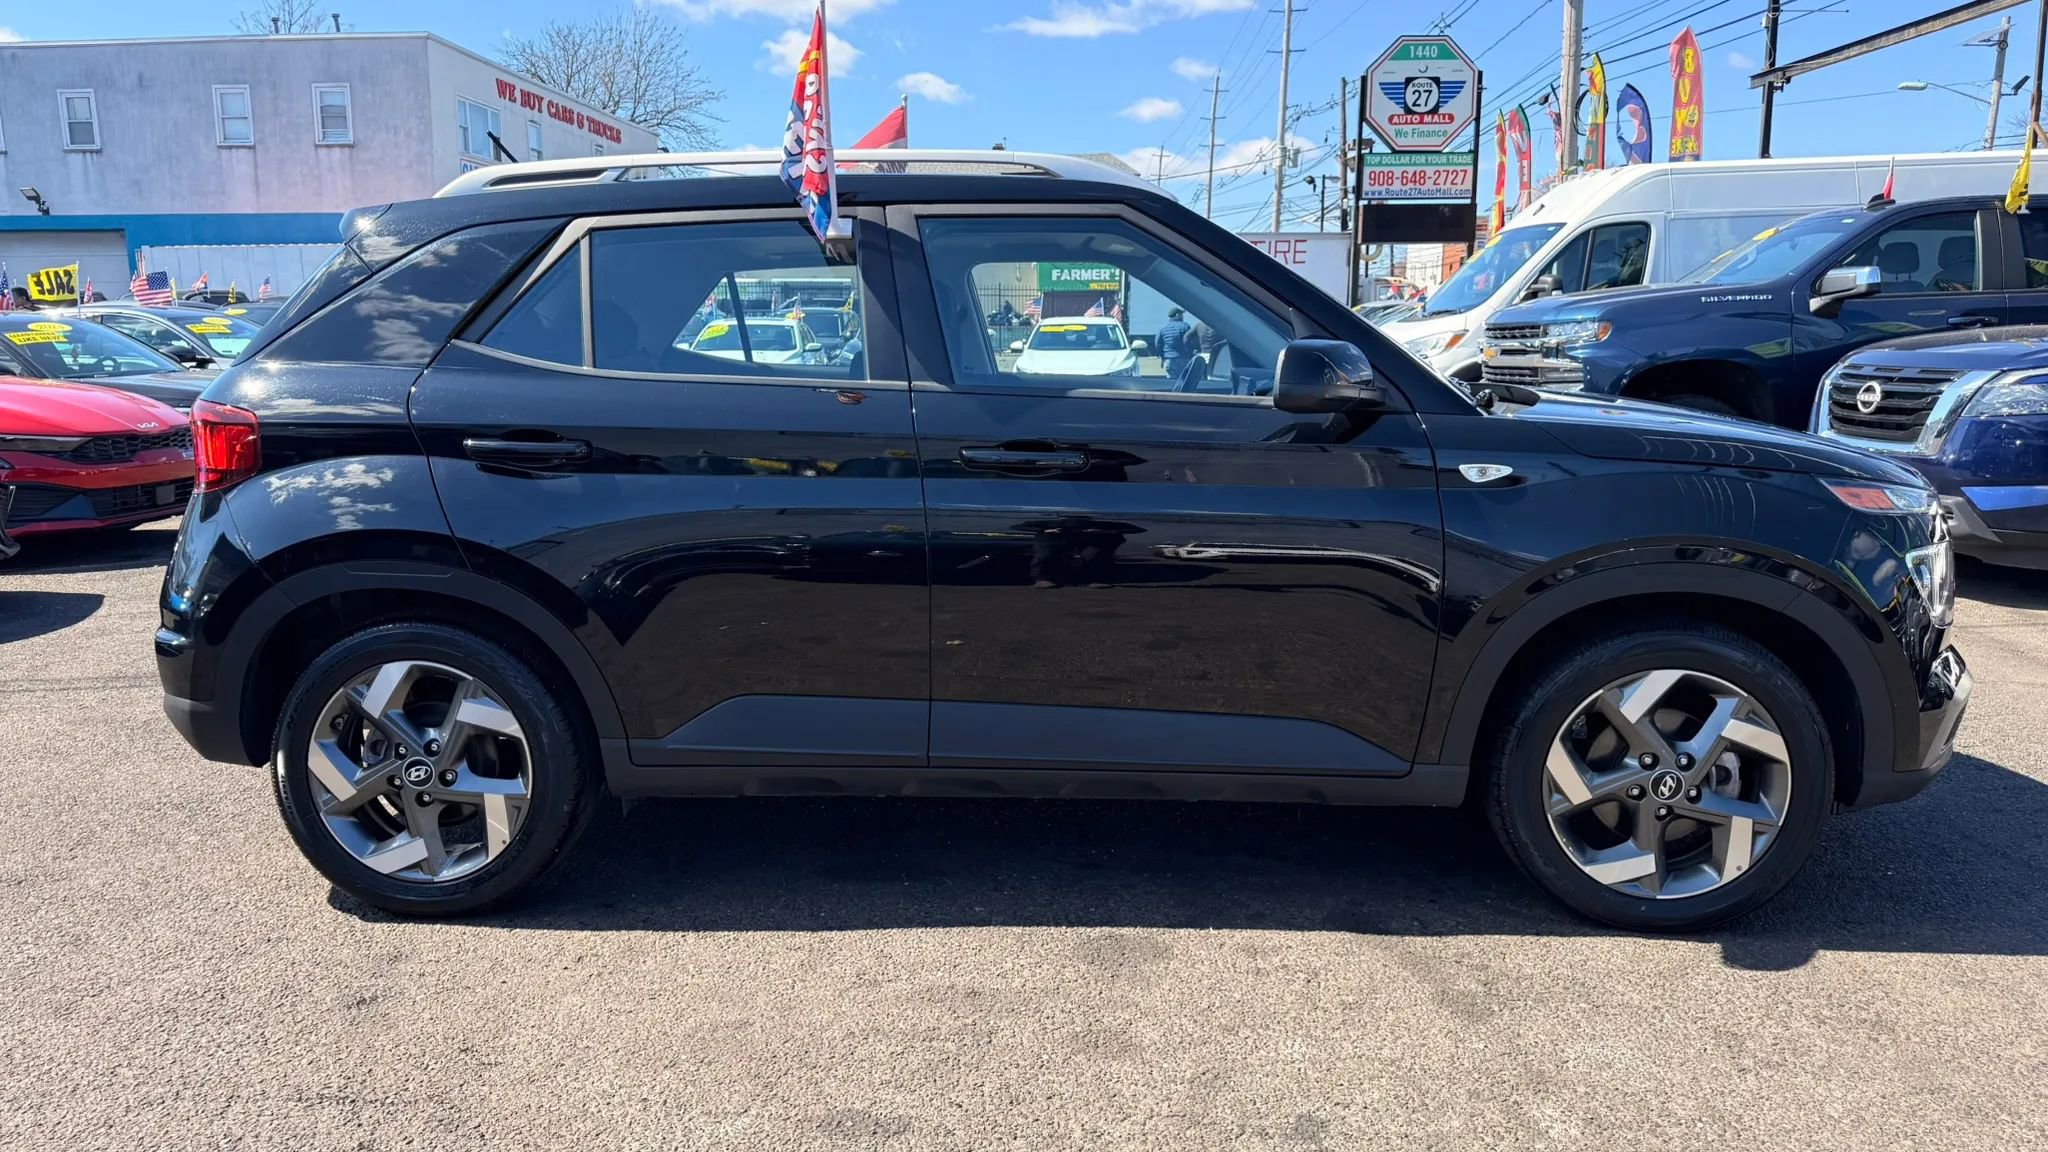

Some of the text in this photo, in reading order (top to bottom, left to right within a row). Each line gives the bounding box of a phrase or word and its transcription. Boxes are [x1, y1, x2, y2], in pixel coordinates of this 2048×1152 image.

[1409, 45, 1438, 58] 1440
[1411, 89, 1433, 107] 27
[495, 78, 517, 103] WE
[519, 88, 545, 113] BUY
[546, 100, 575, 126] CARS
[586, 115, 622, 144] TRUCKS
[1391, 113, 1451, 124] AUTO MALL
[1394, 127, 1449, 138] We Finance
[1366, 154, 1473, 165] TOP DOLLAR FOR YOUR TRADE
[1368, 169, 1468, 187] 908-648-2727
[1363, 187, 1471, 197] www.Route27AutoMall.com
